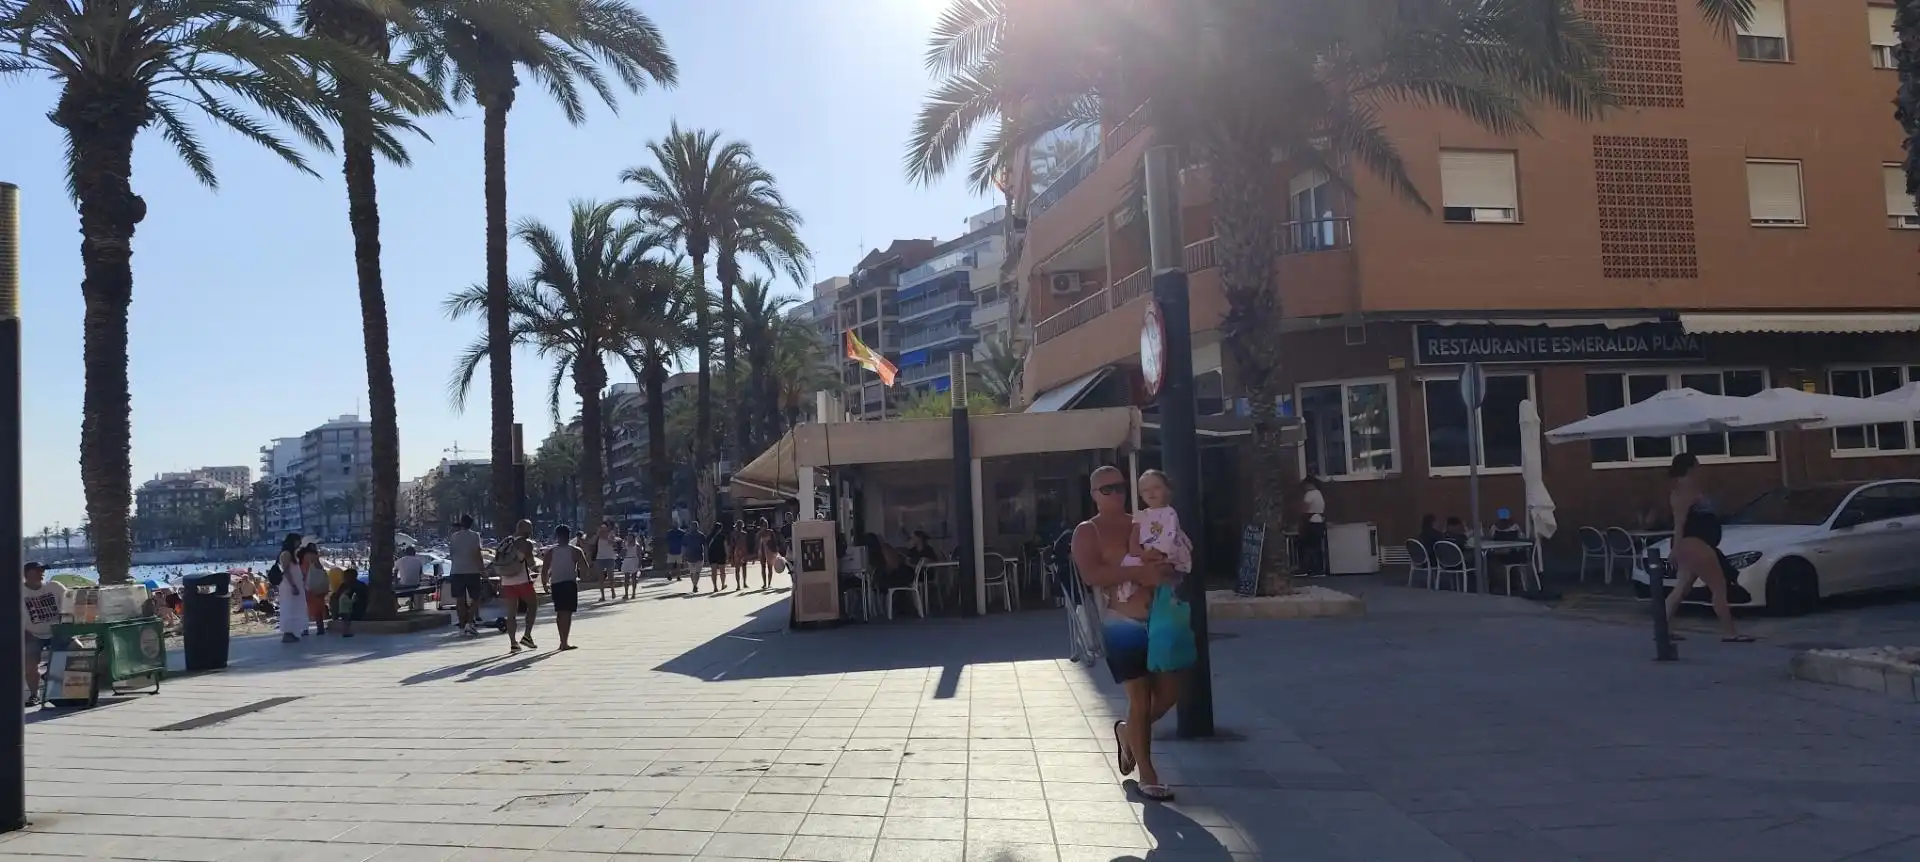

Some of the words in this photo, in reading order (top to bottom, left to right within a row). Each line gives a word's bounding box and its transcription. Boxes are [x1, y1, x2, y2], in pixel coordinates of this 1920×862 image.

[1428, 336, 1547, 356] RESTAURANTE
[1552, 335, 1648, 354] ESMERALDA
[1653, 333, 1700, 351] PLAYA
